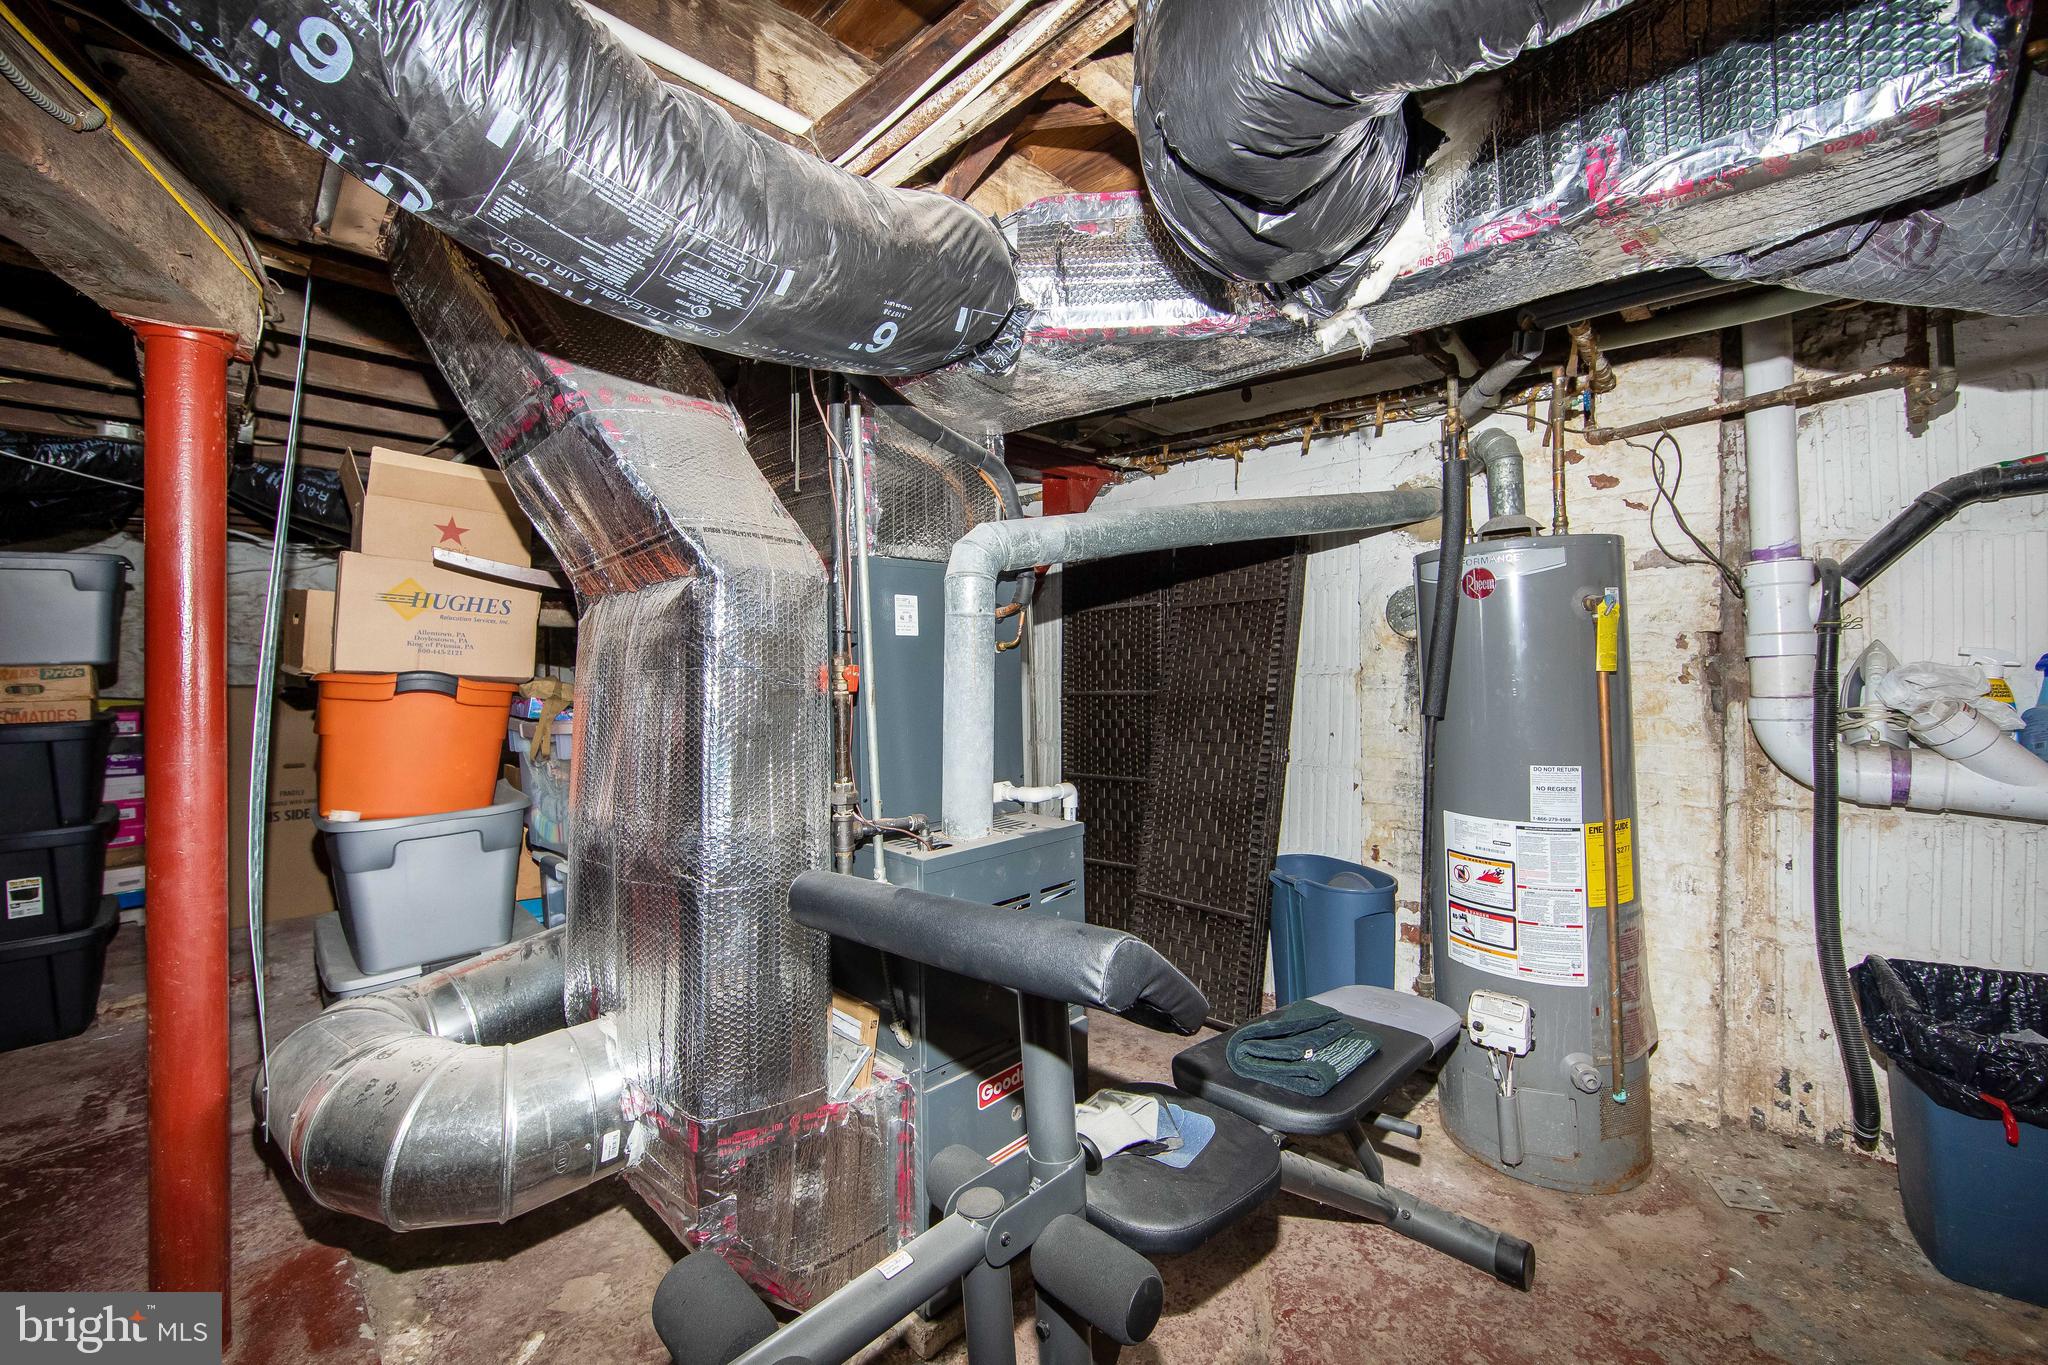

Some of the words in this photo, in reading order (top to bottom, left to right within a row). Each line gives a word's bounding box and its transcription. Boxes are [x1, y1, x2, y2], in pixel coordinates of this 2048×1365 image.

[322, 0, 367, 39] 1187
[1823, 129, 1878, 154] 02/20
[496, 236, 551, 267] DUCT
[553, 265, 581, 284] AIR
[584, 283, 663, 318] FLEXIBLE
[673, 319, 721, 338] CLASS
[297, 483, 329, 501] R-8.0
[1466, 569, 1495, 599] Rheem
[410, 591, 512, 616] HUGHES
[44, 667, 84, 678] Pride
[284, 808, 311, 822] SIDE
[981, 1068, 1023, 1101] Good
